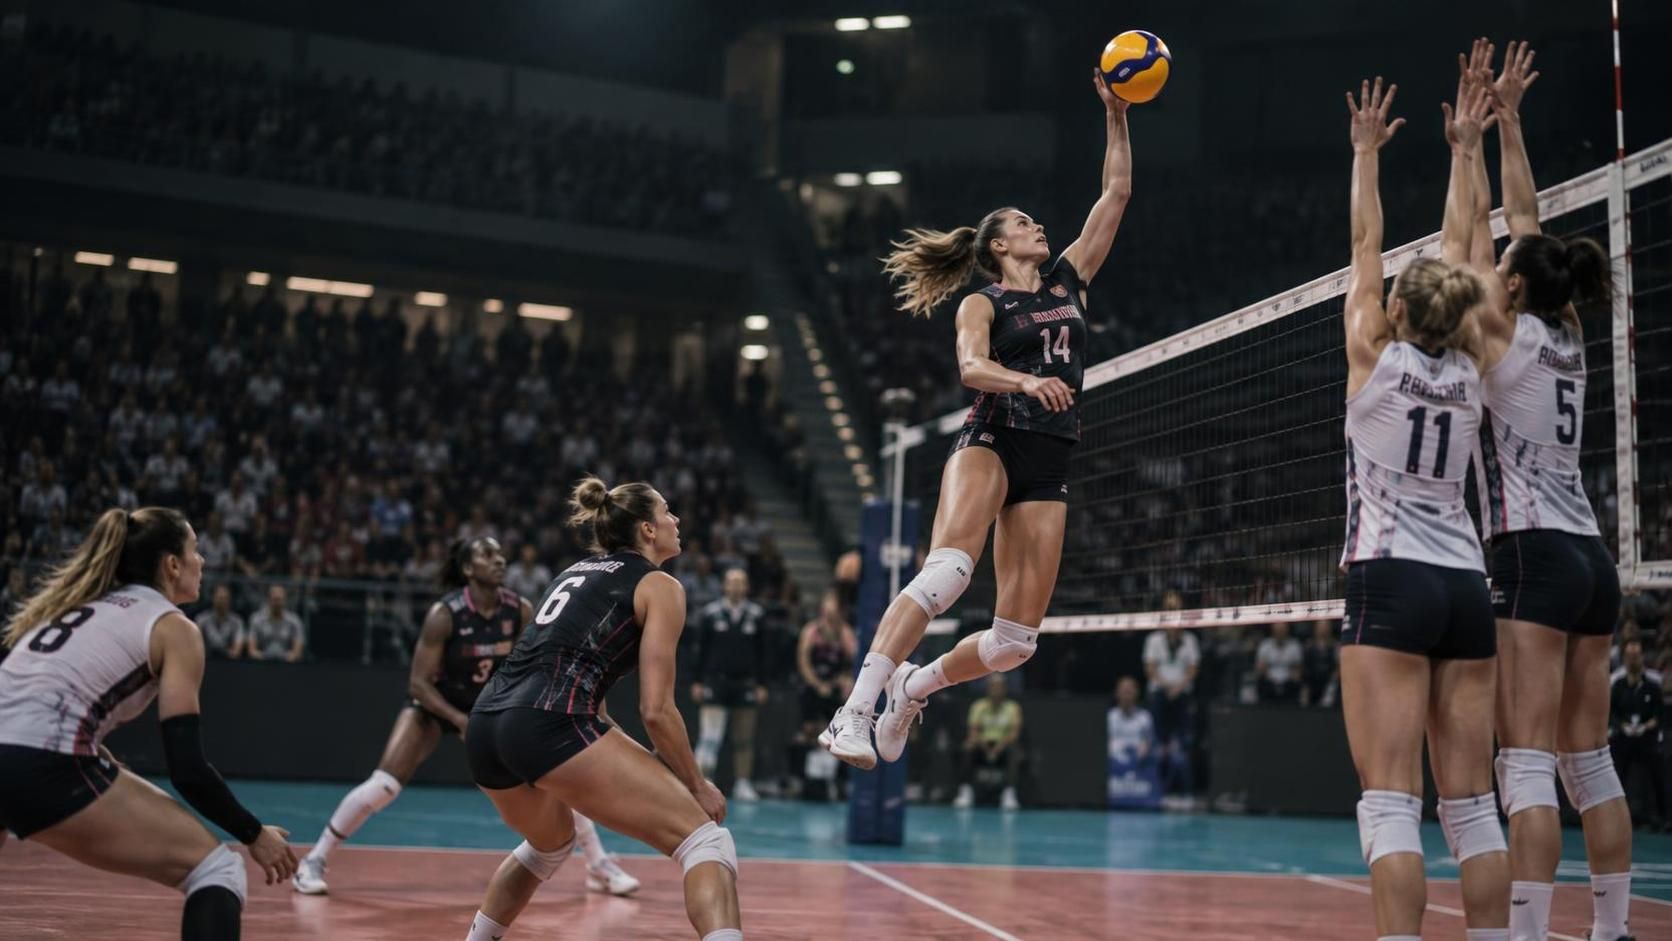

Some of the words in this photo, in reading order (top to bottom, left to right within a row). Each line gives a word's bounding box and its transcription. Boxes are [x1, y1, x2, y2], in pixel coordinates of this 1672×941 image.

[1040, 326, 1071, 364] 14
[1556, 378, 1577, 445] 5
[1406, 407, 1451, 478] 11
[535, 576, 586, 625] 6
[29, 605, 94, 653] 8
[472, 658, 494, 683] 3
